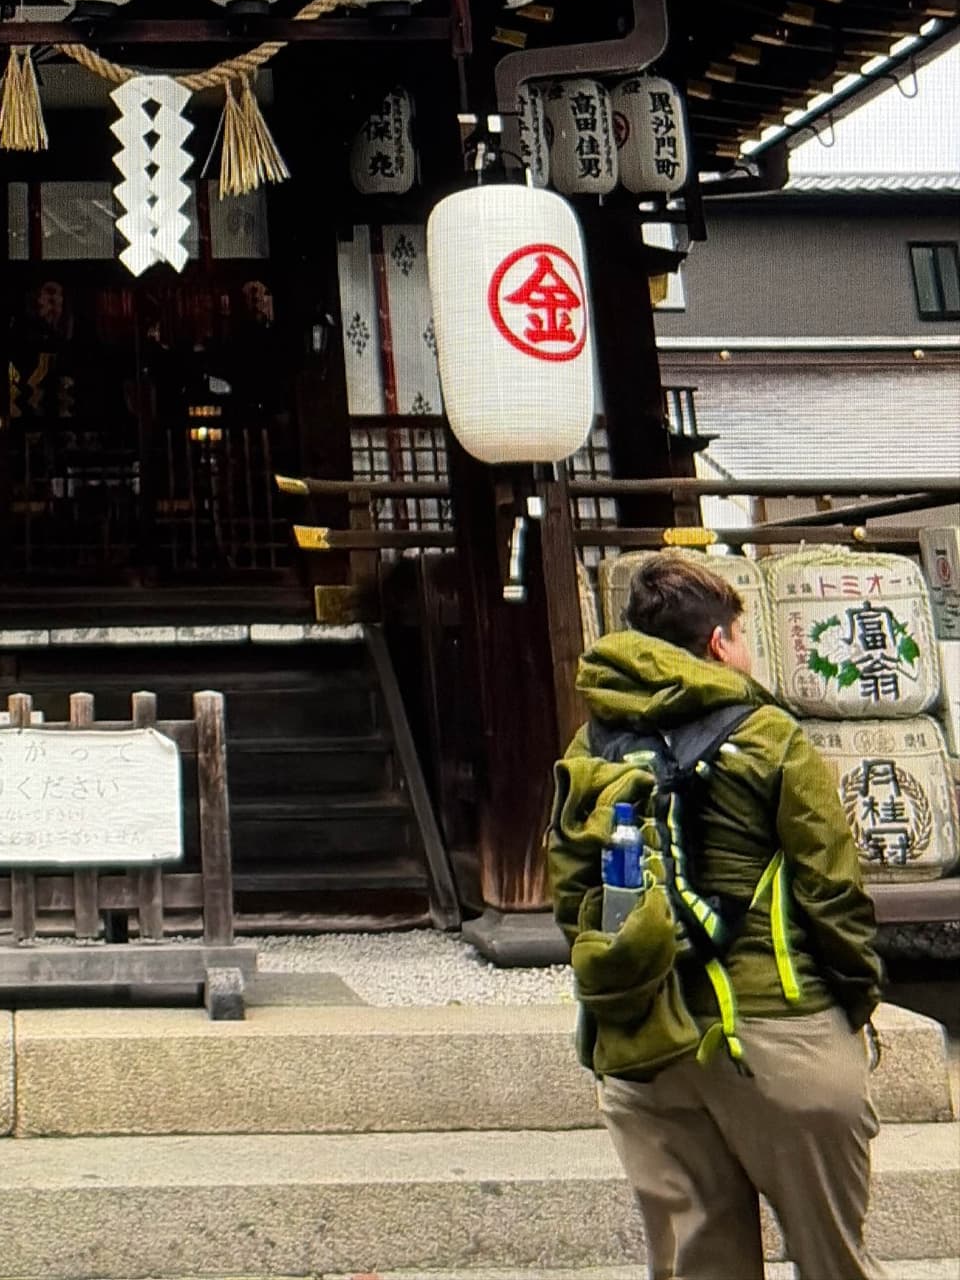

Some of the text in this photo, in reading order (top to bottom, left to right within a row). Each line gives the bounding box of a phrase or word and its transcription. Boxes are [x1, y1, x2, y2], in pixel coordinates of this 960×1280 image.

[503, 254, 581, 344] 金
[841, 599, 908, 703] 富翁
[859, 758, 911, 866] 月桂冠
